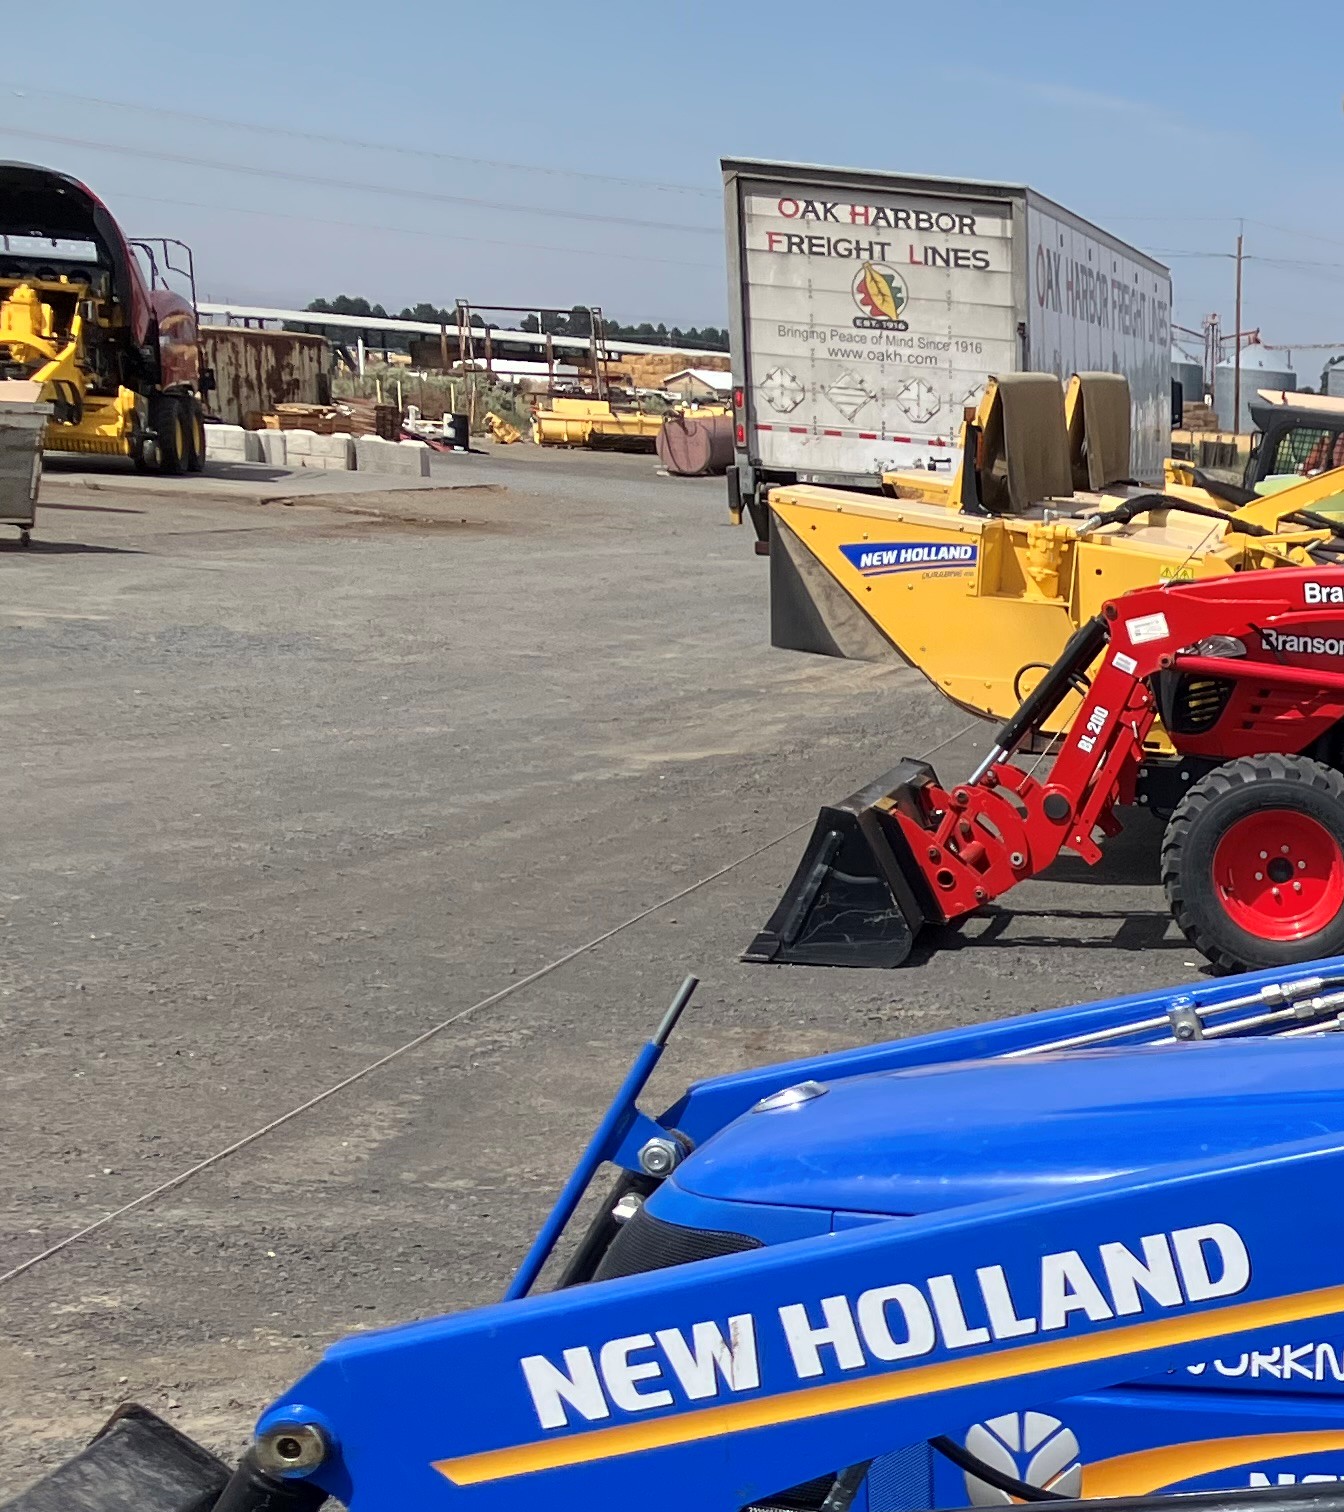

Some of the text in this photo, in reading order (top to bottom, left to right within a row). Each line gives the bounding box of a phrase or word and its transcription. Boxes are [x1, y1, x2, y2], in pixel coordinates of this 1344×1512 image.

[778, 198, 976, 235] OAK HARBOR
[766, 231, 989, 269] FREIGHT LINES
[1036, 243, 1062, 314] OAK
[1066, 257, 1109, 330] HARBOR
[778, 325, 982, 354] Bringing Peace of Mind Since 1916
[827, 347, 937, 366] www.oakh.com
[860, 546, 972, 568] NEW HOLLAND
[1078, 706, 1108, 753] BL 200
[520, 1223, 1252, 1430] NEW HOLLAND
